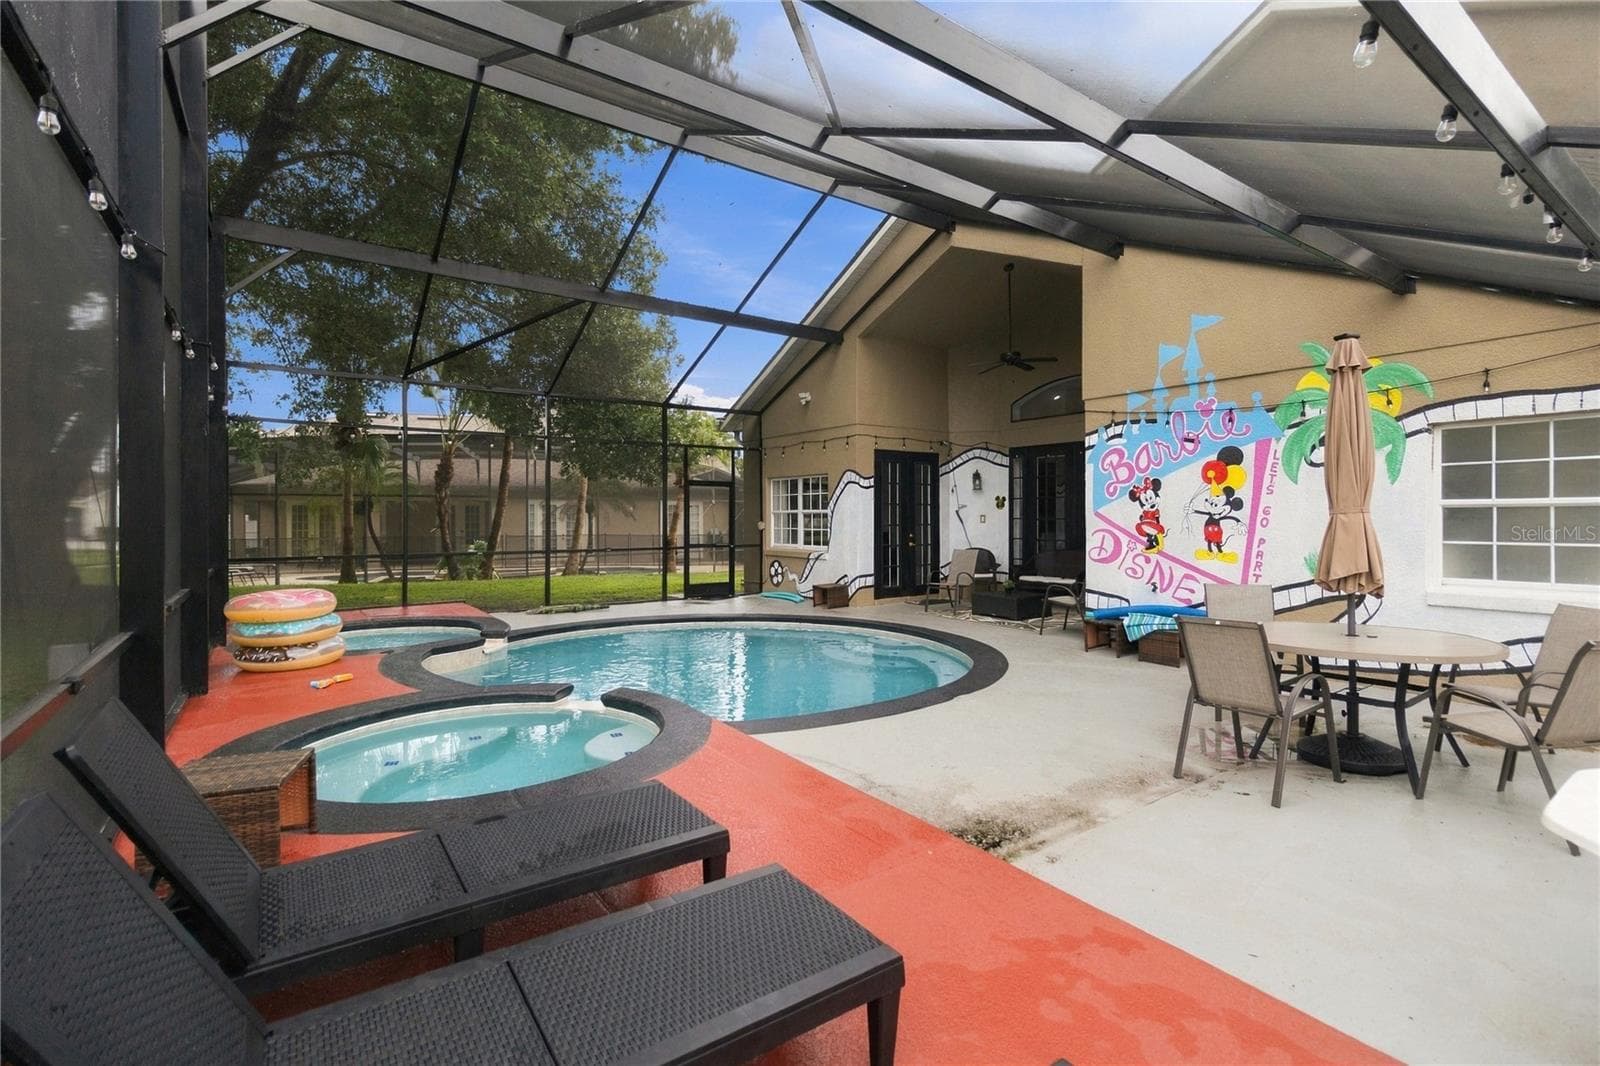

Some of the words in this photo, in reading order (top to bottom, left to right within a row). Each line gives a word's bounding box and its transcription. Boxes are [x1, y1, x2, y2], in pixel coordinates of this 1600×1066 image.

[1099, 397, 1252, 497] Barbie
[1266, 449, 1280, 495] LETS
[1259, 506, 1272, 528] GO
[1088, 528, 1200, 605] DISNE
[1252, 537, 1266, 583] PART
